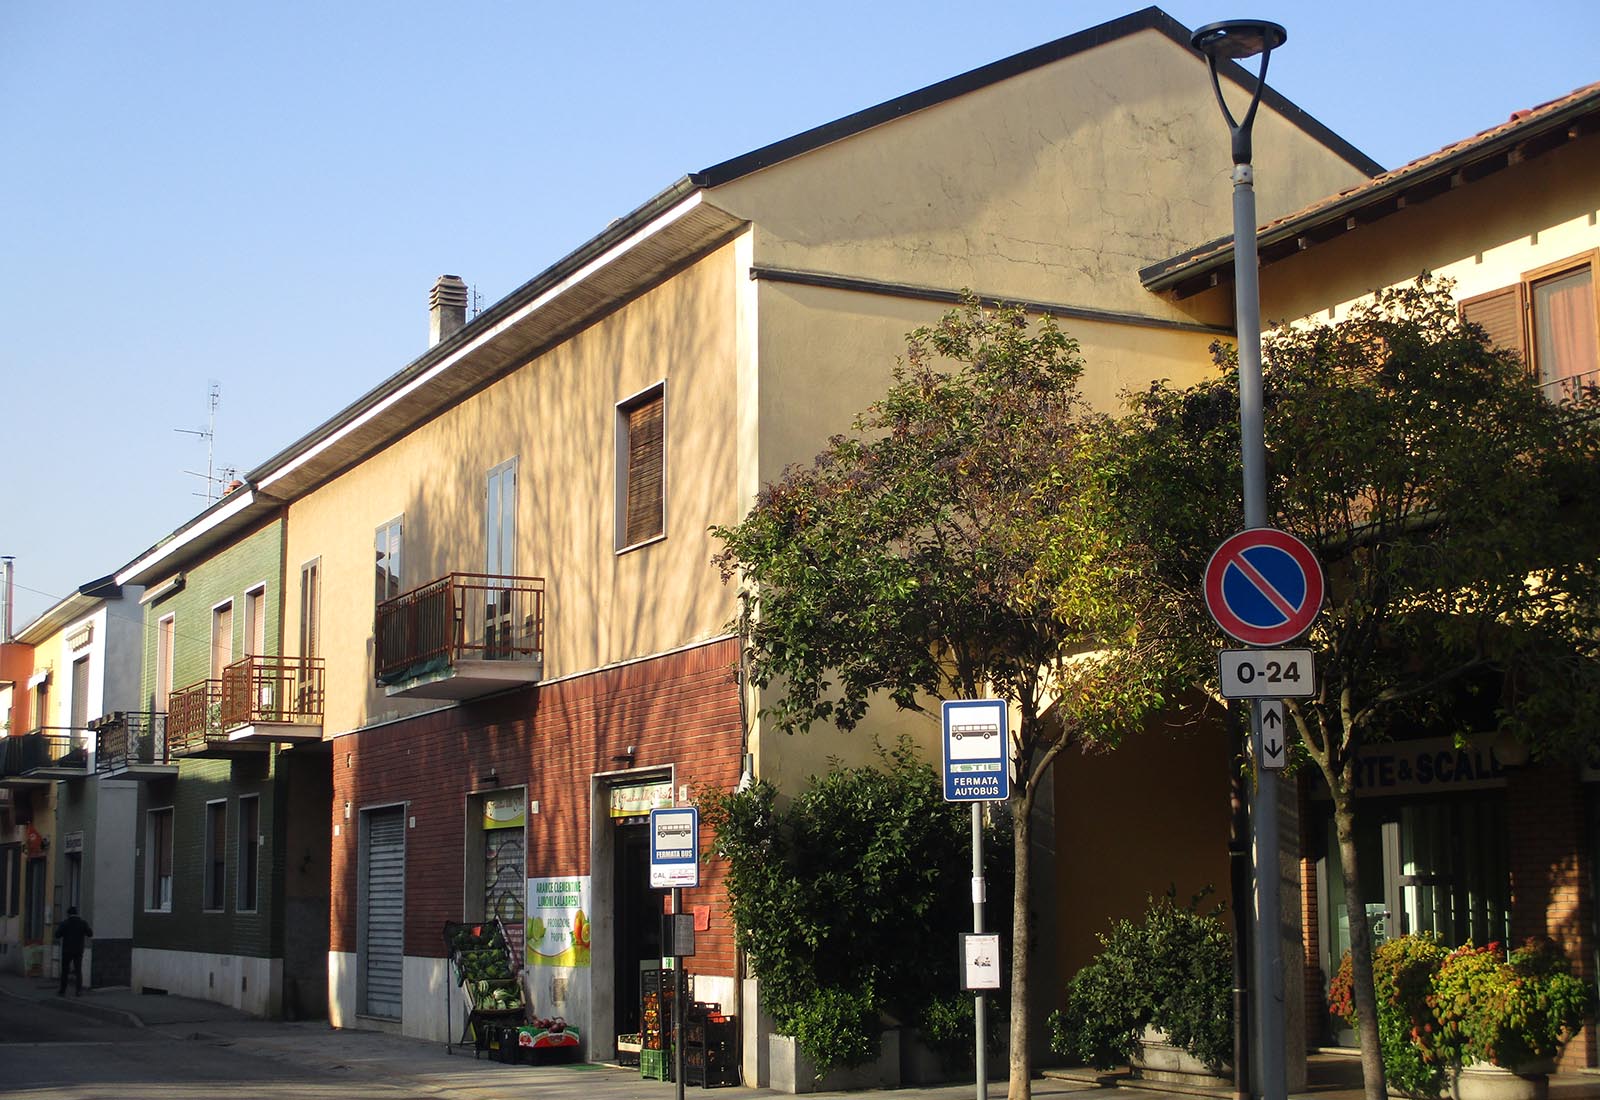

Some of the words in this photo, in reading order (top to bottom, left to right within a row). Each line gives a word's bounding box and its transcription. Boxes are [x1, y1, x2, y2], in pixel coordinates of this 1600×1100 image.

[1237, 661, 1301, 684] 0-24
[960, 763, 1001, 772] STIE
[1399, 761, 1412, 781] &
[954, 776, 1000, 786] FERMATA
[954, 786, 1000, 796] AUTOBUS
[656, 851, 680, 860] FERMATA
[681, 850, 693, 858] BUS
[536, 882, 553, 893] ARANCE
[554, 881, 581, 893] CLEMENTINE
[537, 895, 553, 907] LIMONI
[554, 895, 580, 907] CALABRESI
[547, 918, 571, 928] PRODUZIONE
